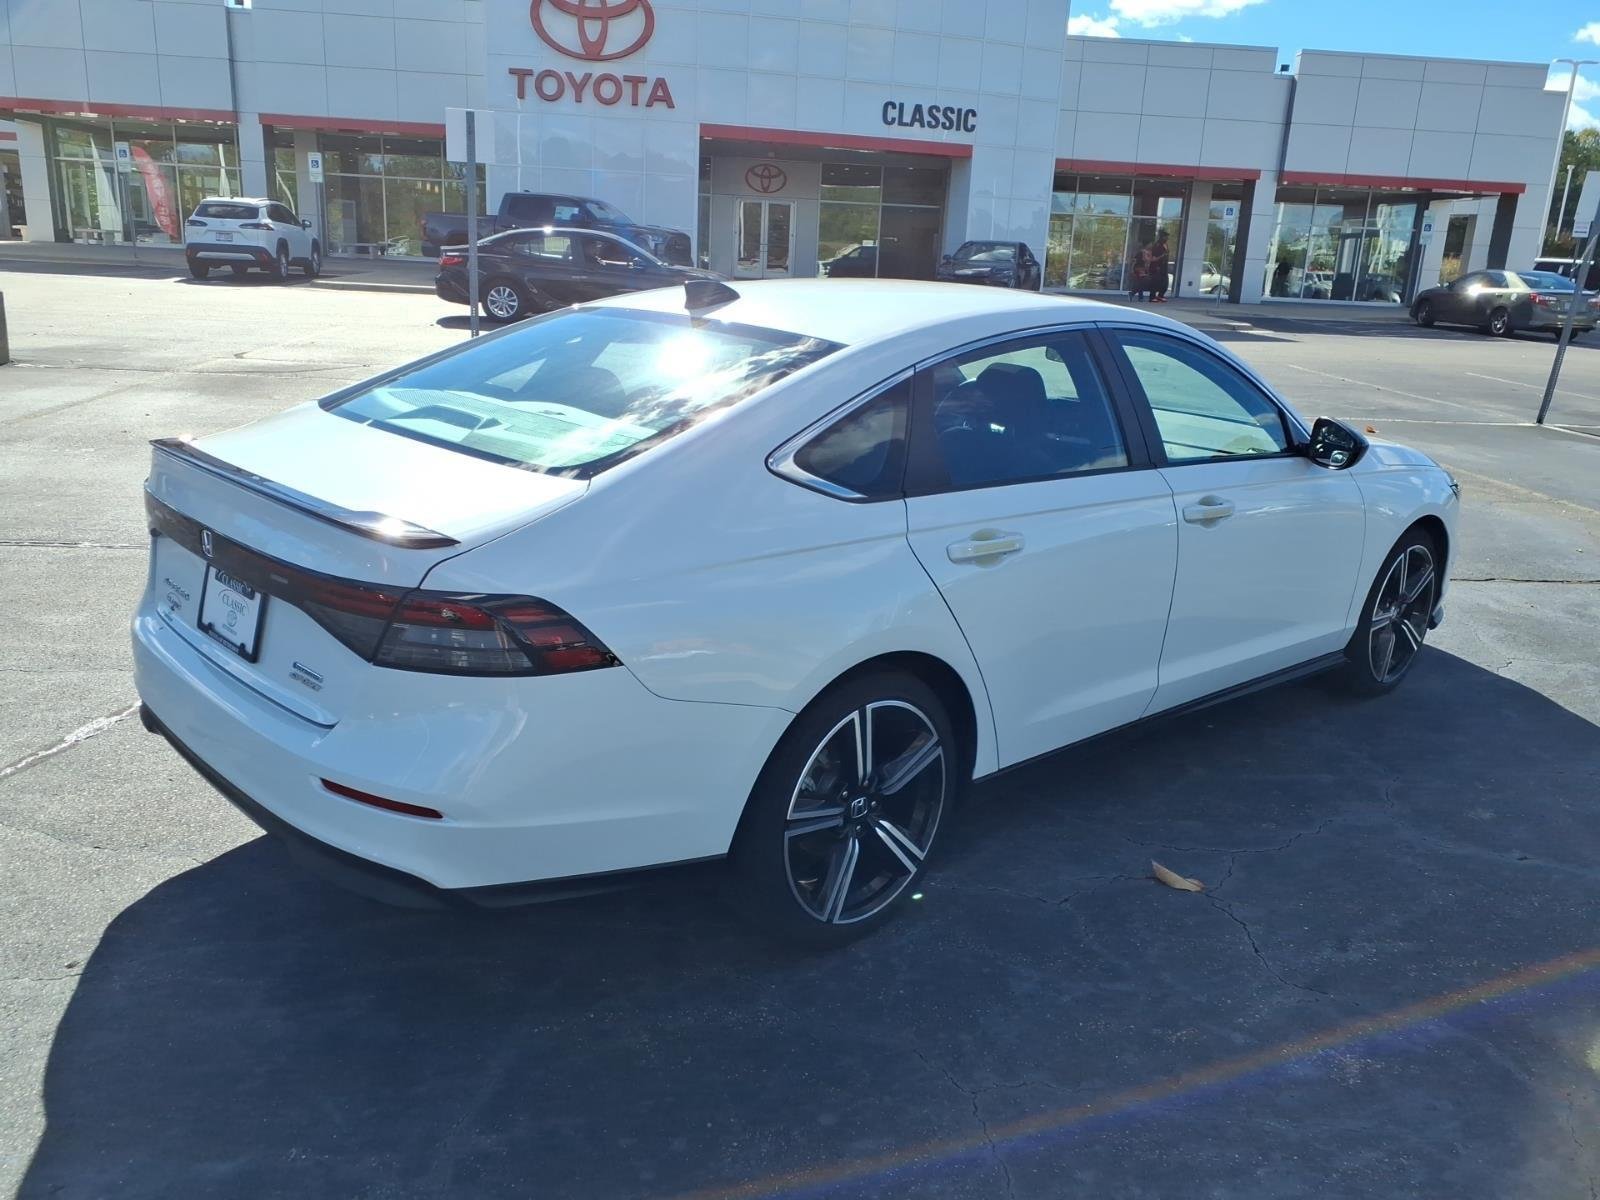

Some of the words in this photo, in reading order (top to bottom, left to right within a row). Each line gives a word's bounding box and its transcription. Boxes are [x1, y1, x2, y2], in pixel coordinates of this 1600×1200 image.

[508, 67, 675, 109] TOYOTA
[882, 100, 977, 133] CLASSIC
[221, 573, 246, 594] CLASSIC
[221, 593, 248, 617] CLASSIC
